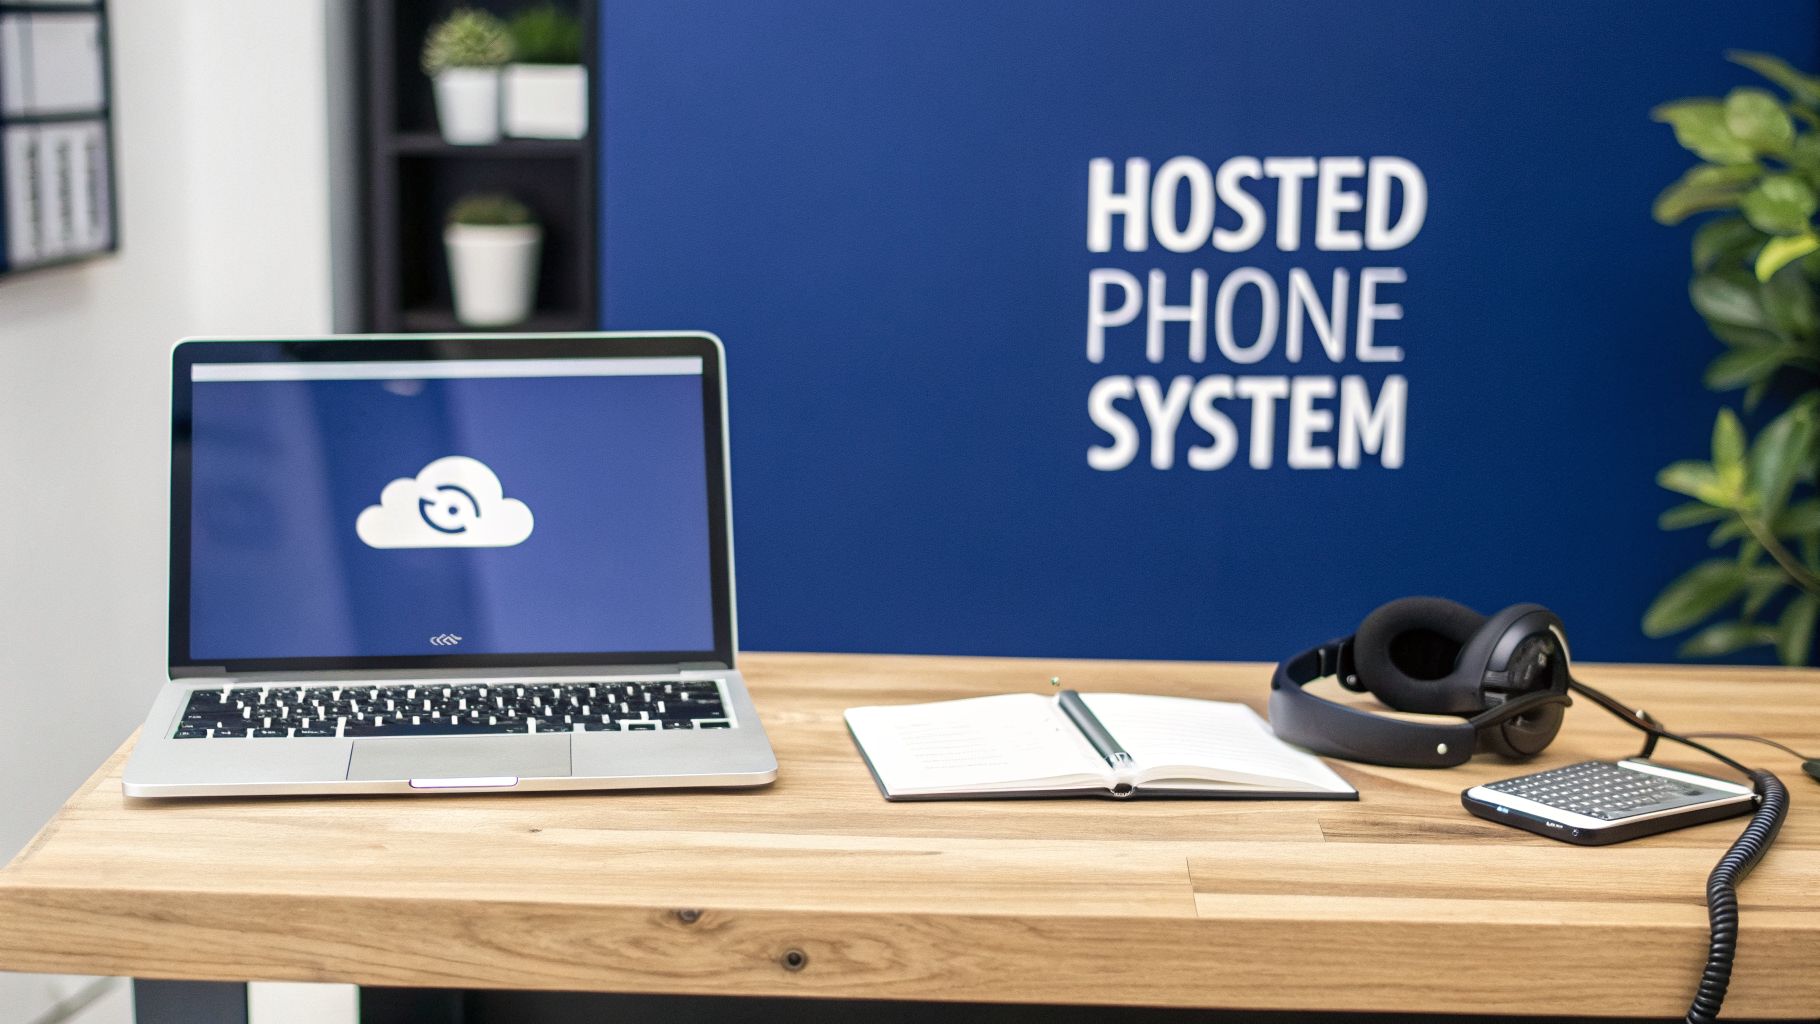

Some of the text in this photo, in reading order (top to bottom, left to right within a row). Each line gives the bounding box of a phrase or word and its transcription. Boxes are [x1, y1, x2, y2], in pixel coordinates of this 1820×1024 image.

[1086, 155, 1428, 253] HOSTED
[1086, 266, 1408, 364] PHONE
[1086, 374, 1408, 471] SYSTEM
